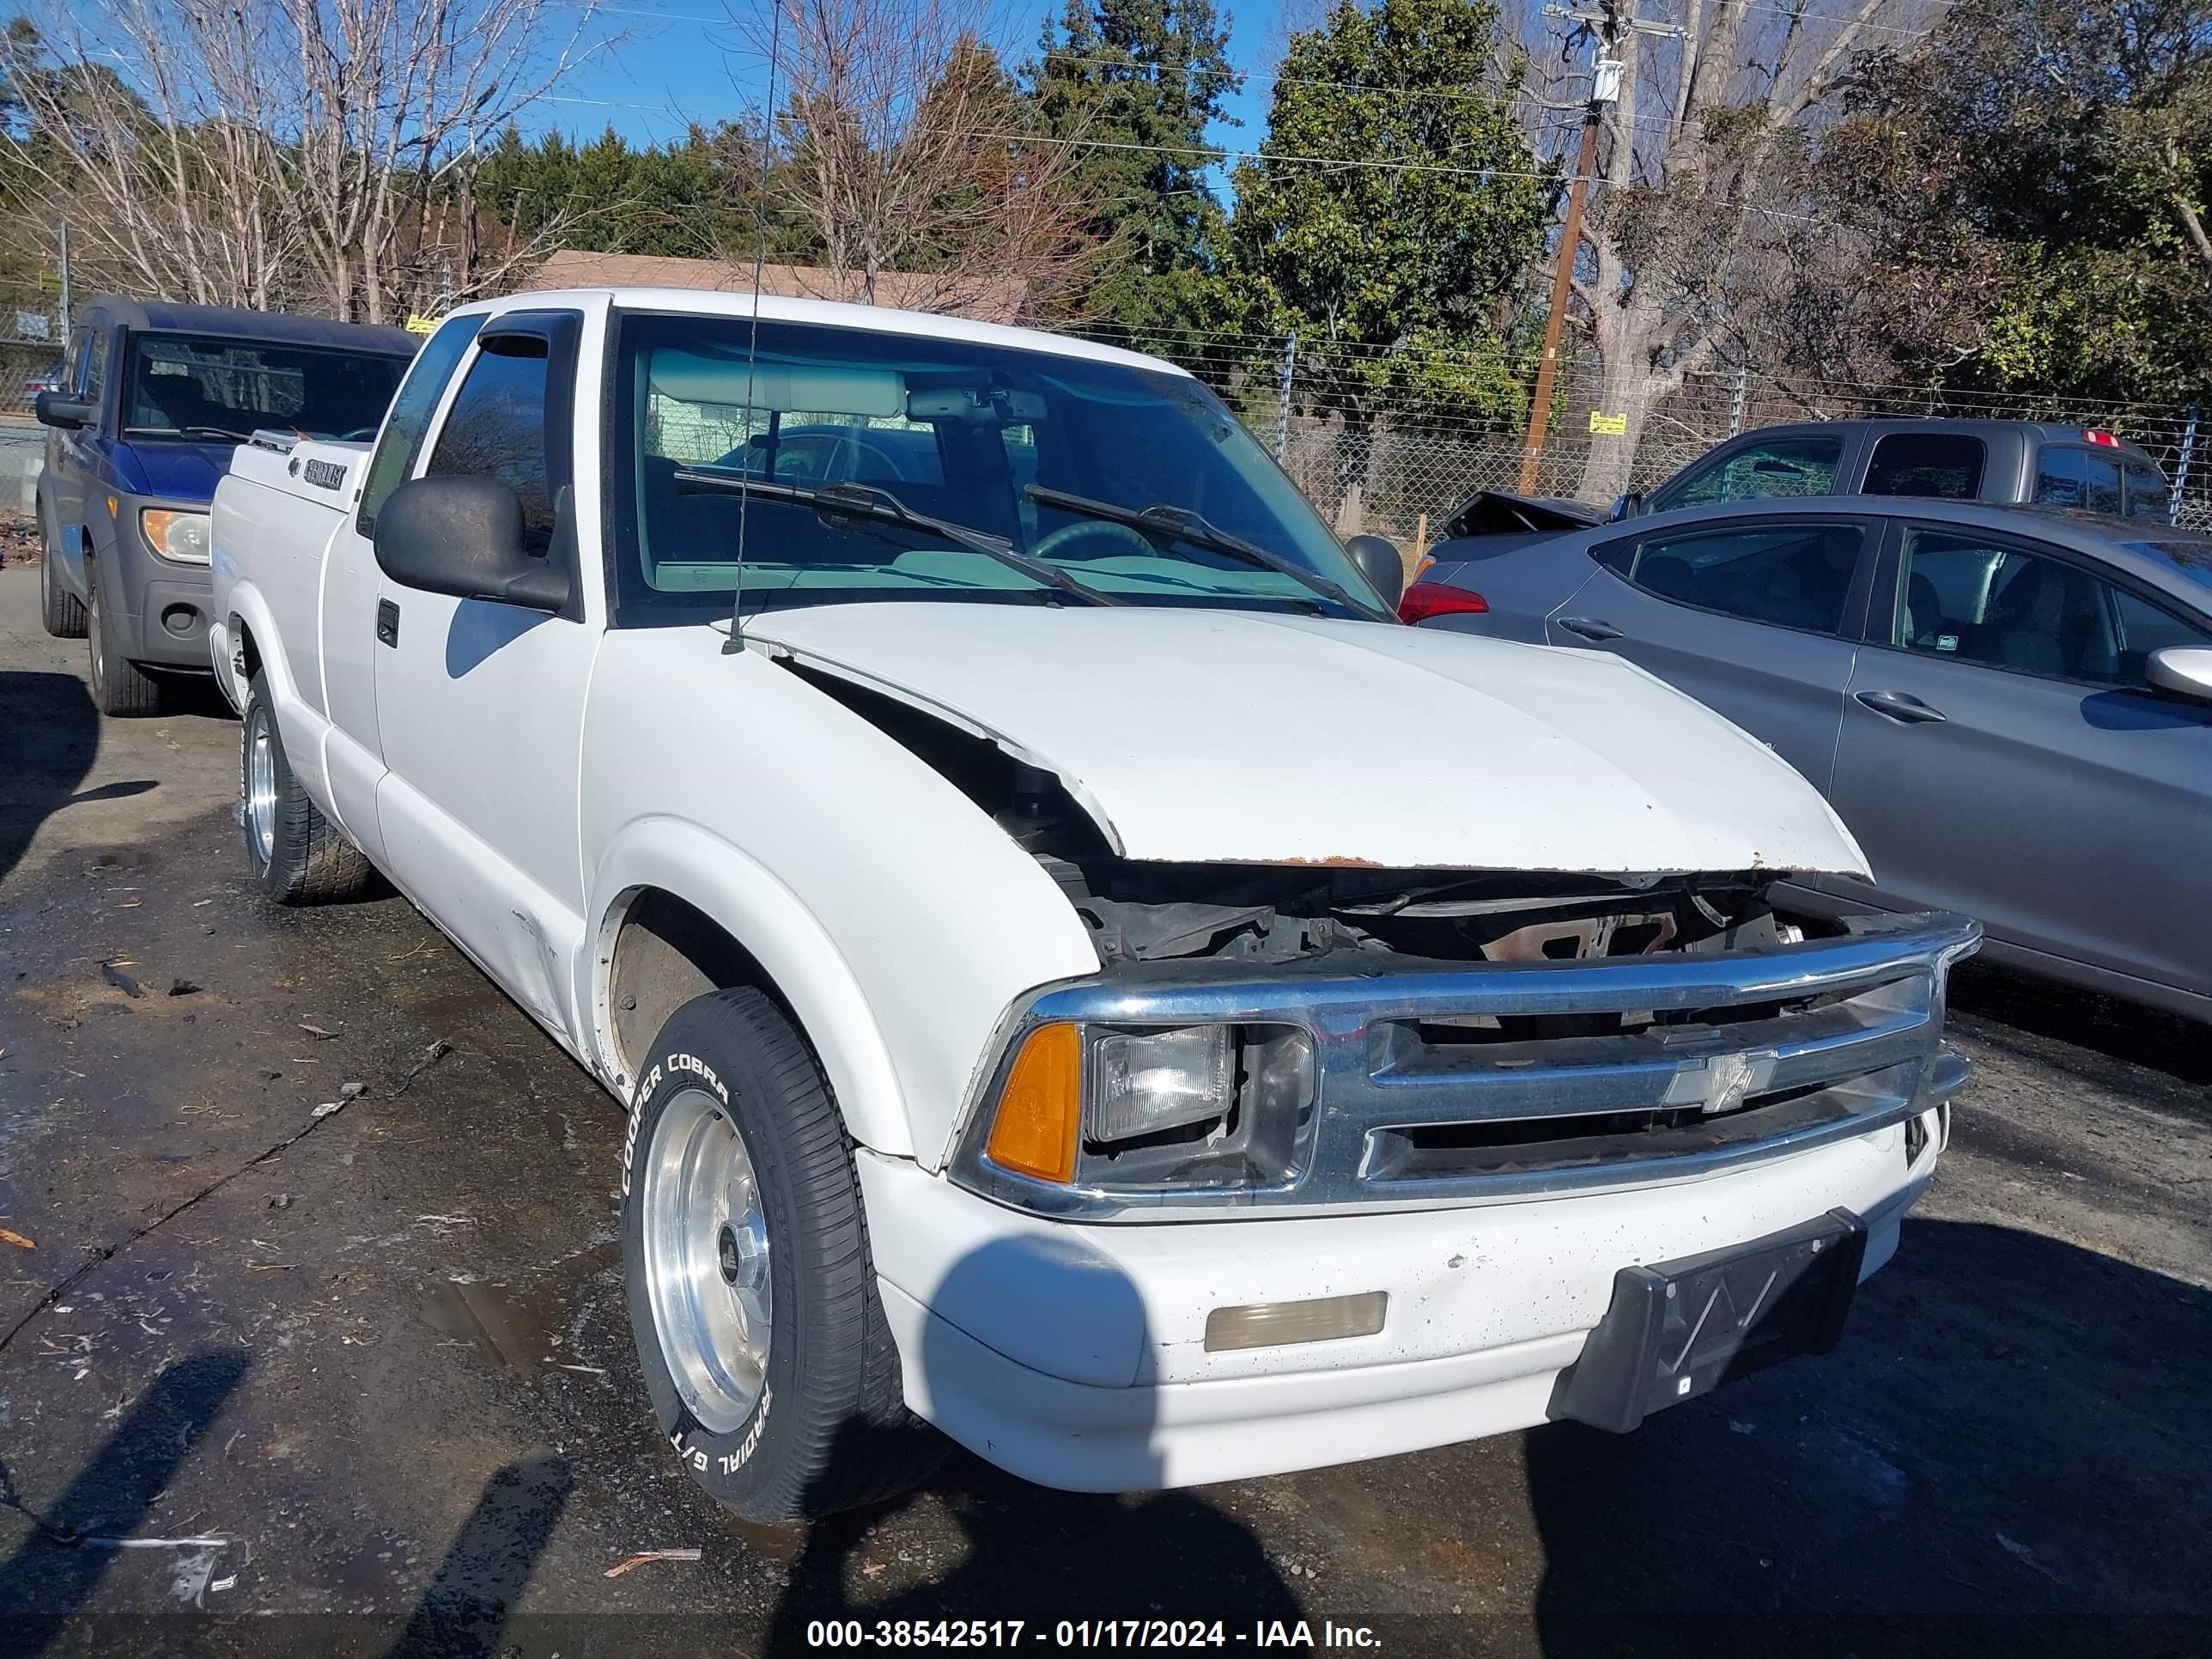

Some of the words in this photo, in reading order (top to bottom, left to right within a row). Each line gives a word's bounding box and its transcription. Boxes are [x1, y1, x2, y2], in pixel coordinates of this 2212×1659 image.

[621, 1063, 663, 1197] COOPER
[666, 1053, 729, 1106] COBRA
[717, 1379, 773, 1476] RADIAL
